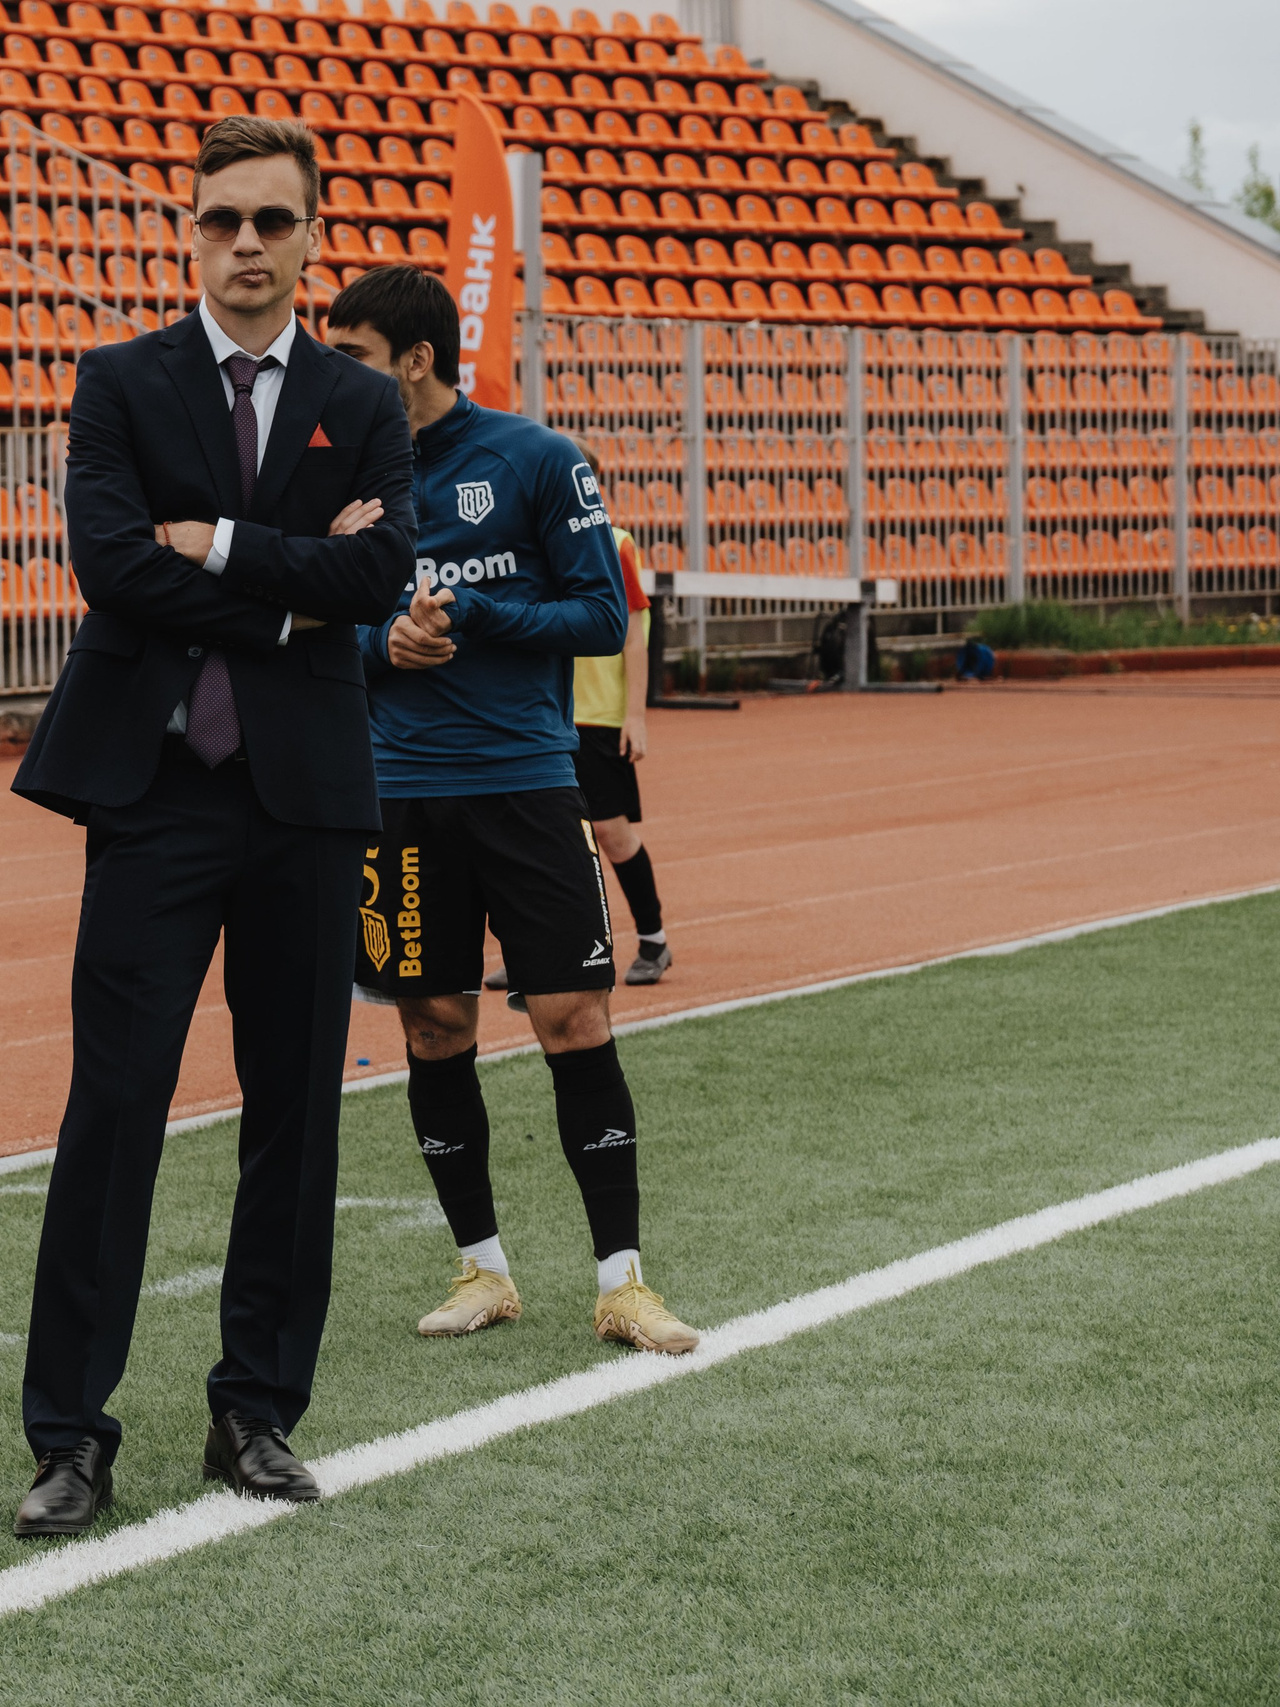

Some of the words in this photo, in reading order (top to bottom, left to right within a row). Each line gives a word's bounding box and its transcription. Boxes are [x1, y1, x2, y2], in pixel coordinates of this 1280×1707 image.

[568, 509, 611, 534] BetB
[404, 551, 517, 592] Boom
[397, 847, 422, 977] BetBoom
[583, 956, 611, 967] DEMIX
[583, 1137, 636, 1150] DEMIX
